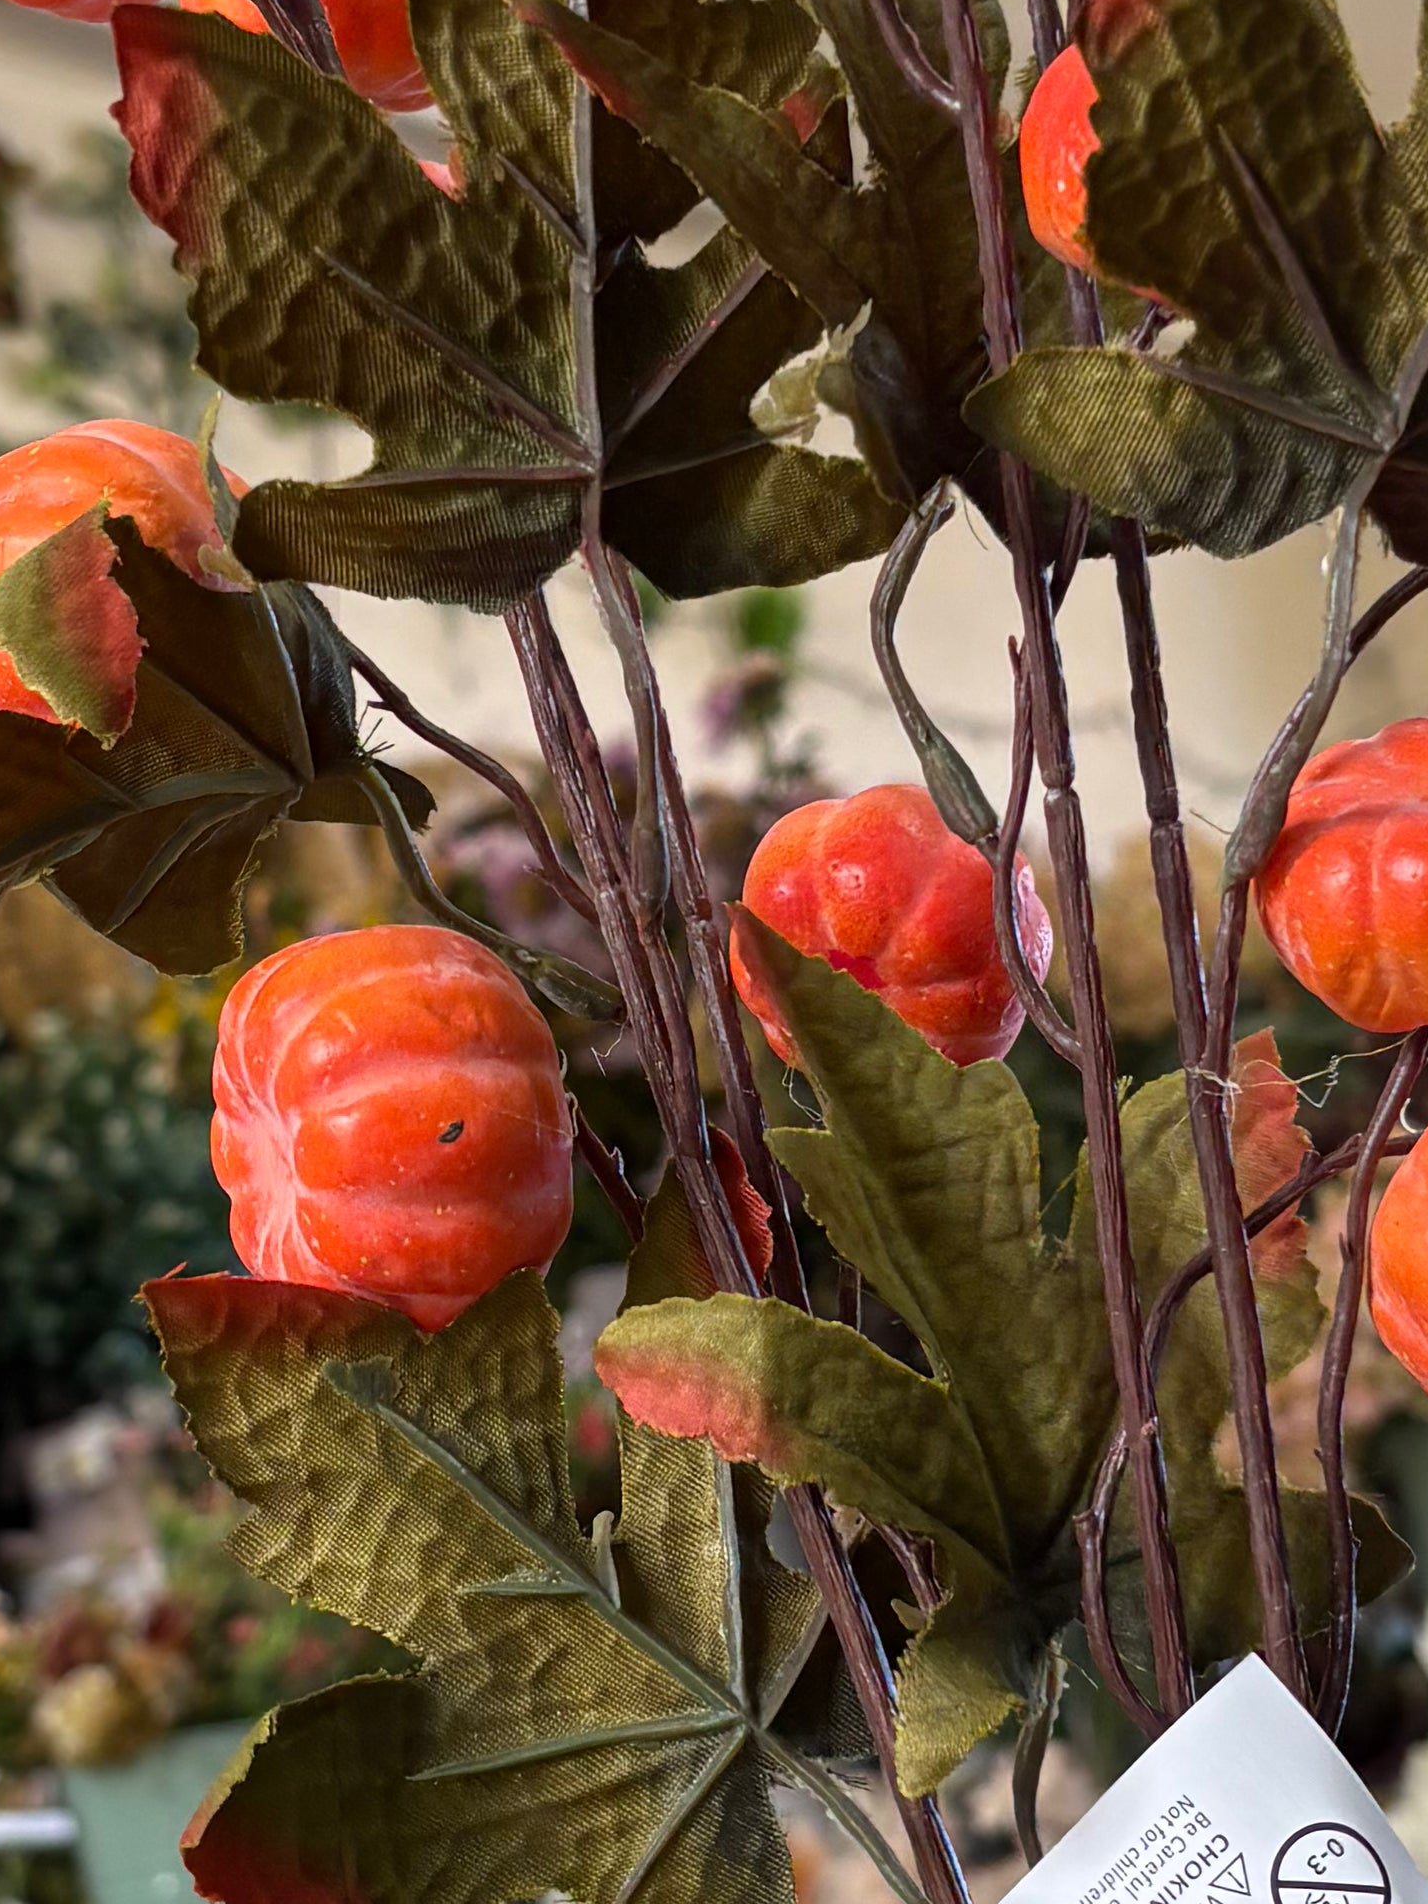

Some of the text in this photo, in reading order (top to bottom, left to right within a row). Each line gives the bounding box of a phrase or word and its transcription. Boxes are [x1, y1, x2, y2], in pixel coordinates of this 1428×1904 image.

[1159, 1793, 1196, 1828] Not
[1182, 1811, 1212, 1837] Be
[1139, 1823, 1167, 1851] for
[1123, 1835, 1187, 1902] Careful
[1306, 1838, 1345, 1876] 0-3
